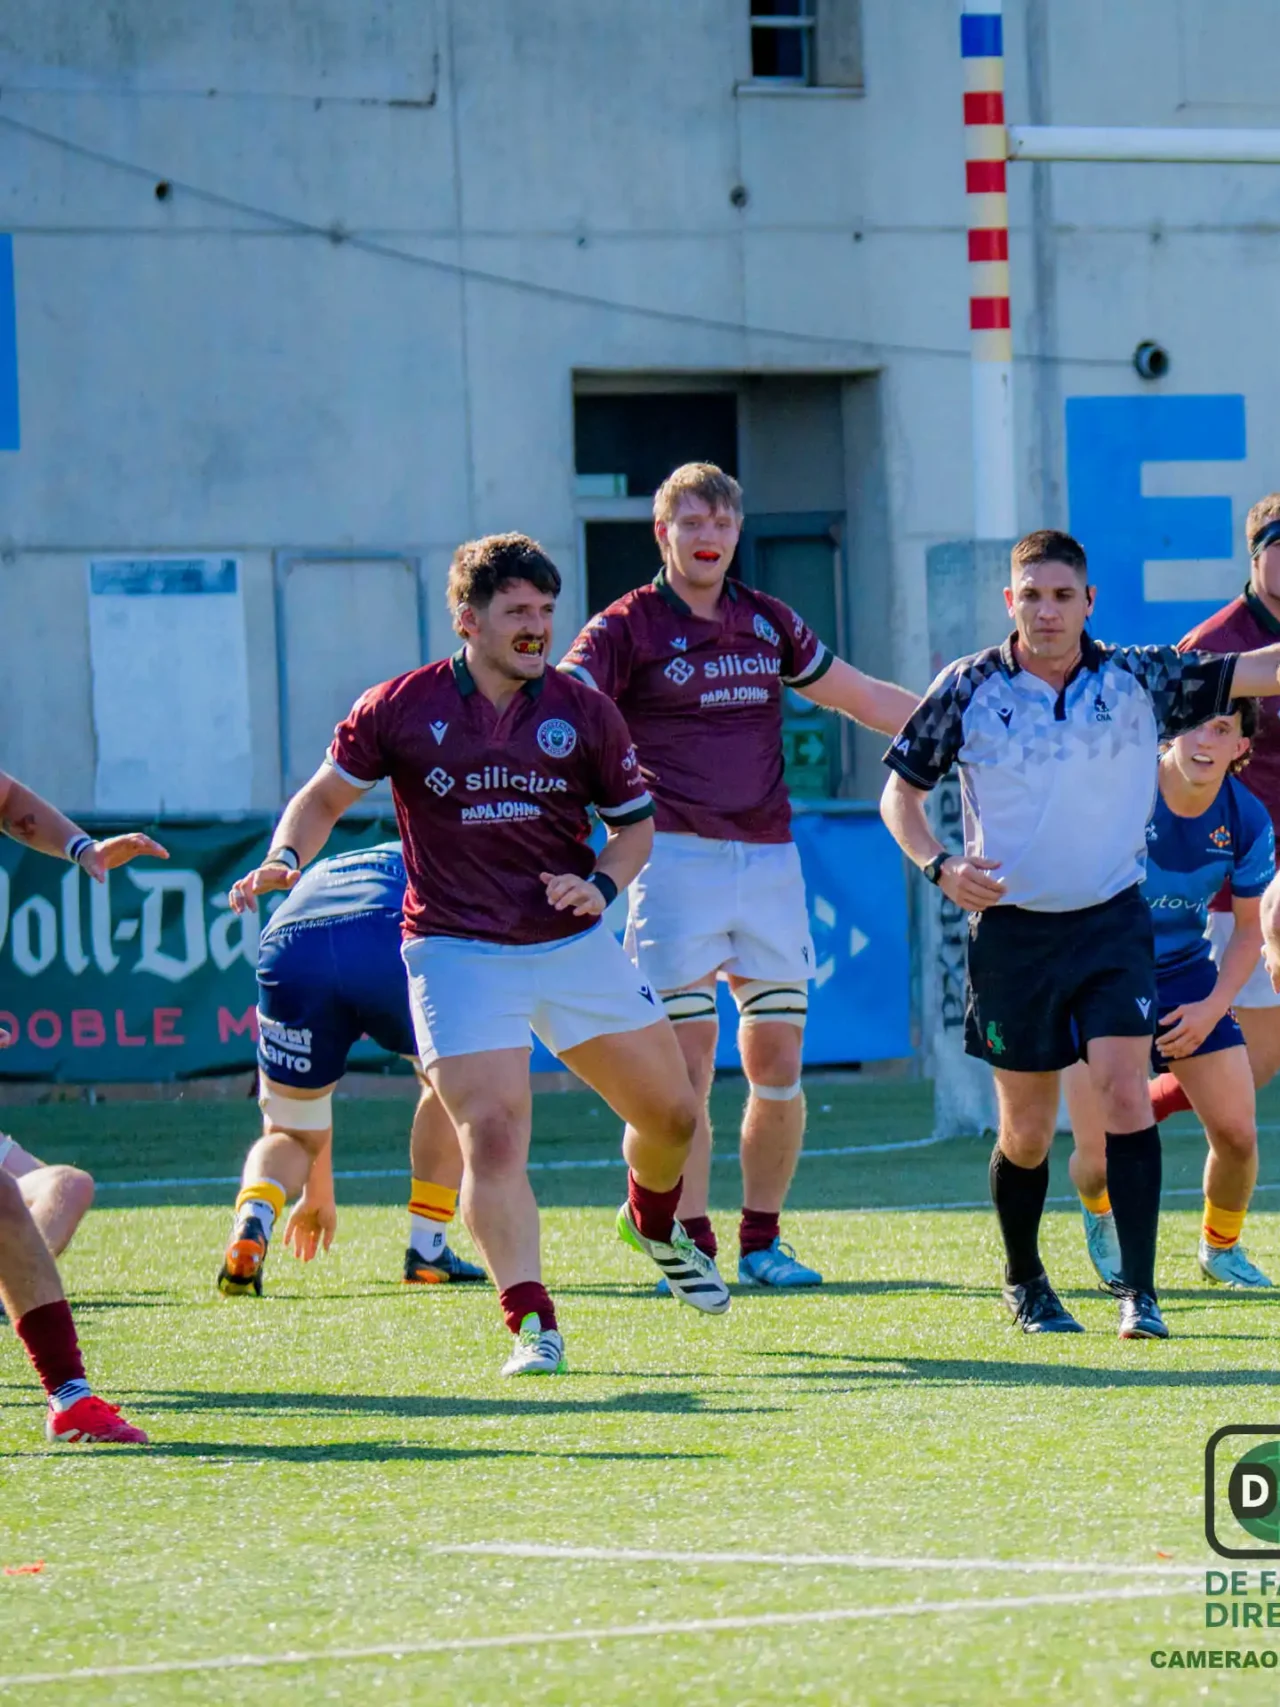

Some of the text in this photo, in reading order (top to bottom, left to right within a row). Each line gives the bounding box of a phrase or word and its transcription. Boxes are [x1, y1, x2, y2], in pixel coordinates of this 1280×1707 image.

[465, 766, 568, 794] silicius
[461, 803, 496, 820] PAPA
[0, 860, 283, 983] oll-Da
[265, 1044, 312, 1074] arro
